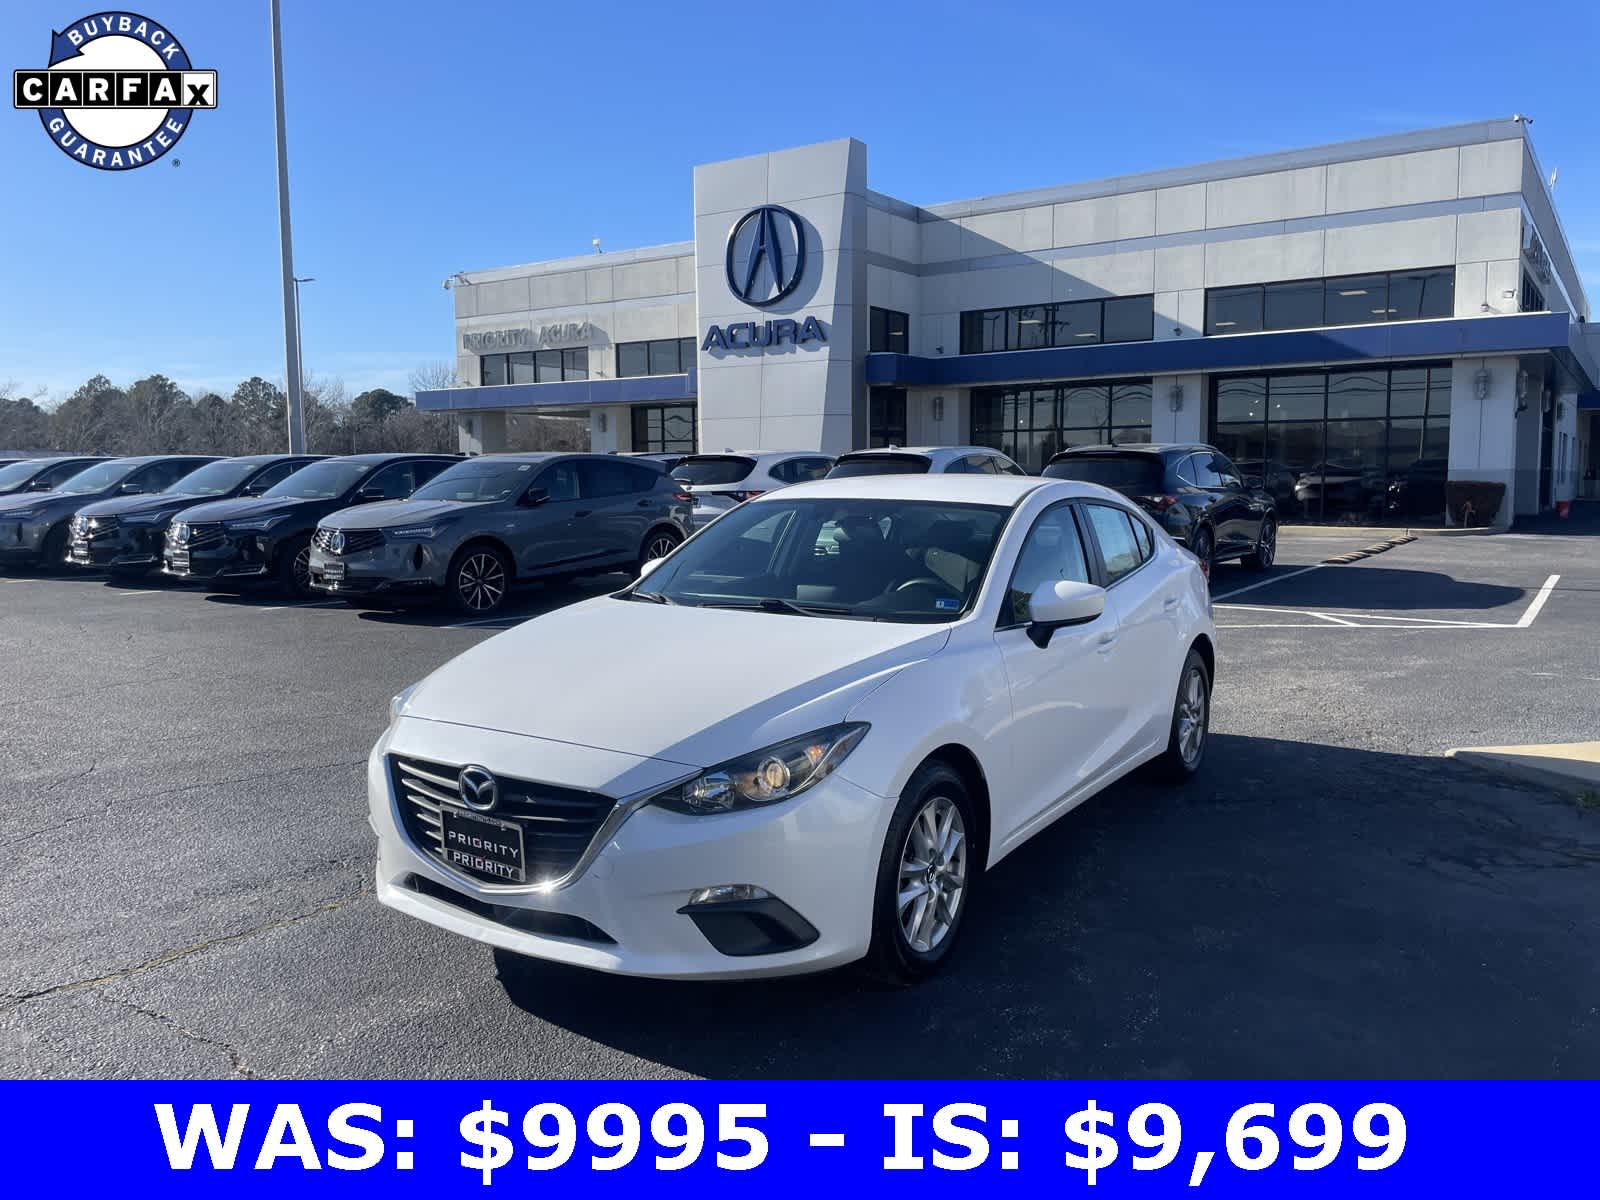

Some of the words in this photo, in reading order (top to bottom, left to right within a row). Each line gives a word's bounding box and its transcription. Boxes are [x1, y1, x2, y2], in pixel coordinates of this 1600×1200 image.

[463, 327, 531, 349] PRIORITY
[538, 321, 594, 345] ACURA
[701, 315, 827, 351] ACURA
[448, 831, 519, 859] PRIORITY
[453, 851, 514, 879] PRIORITY
